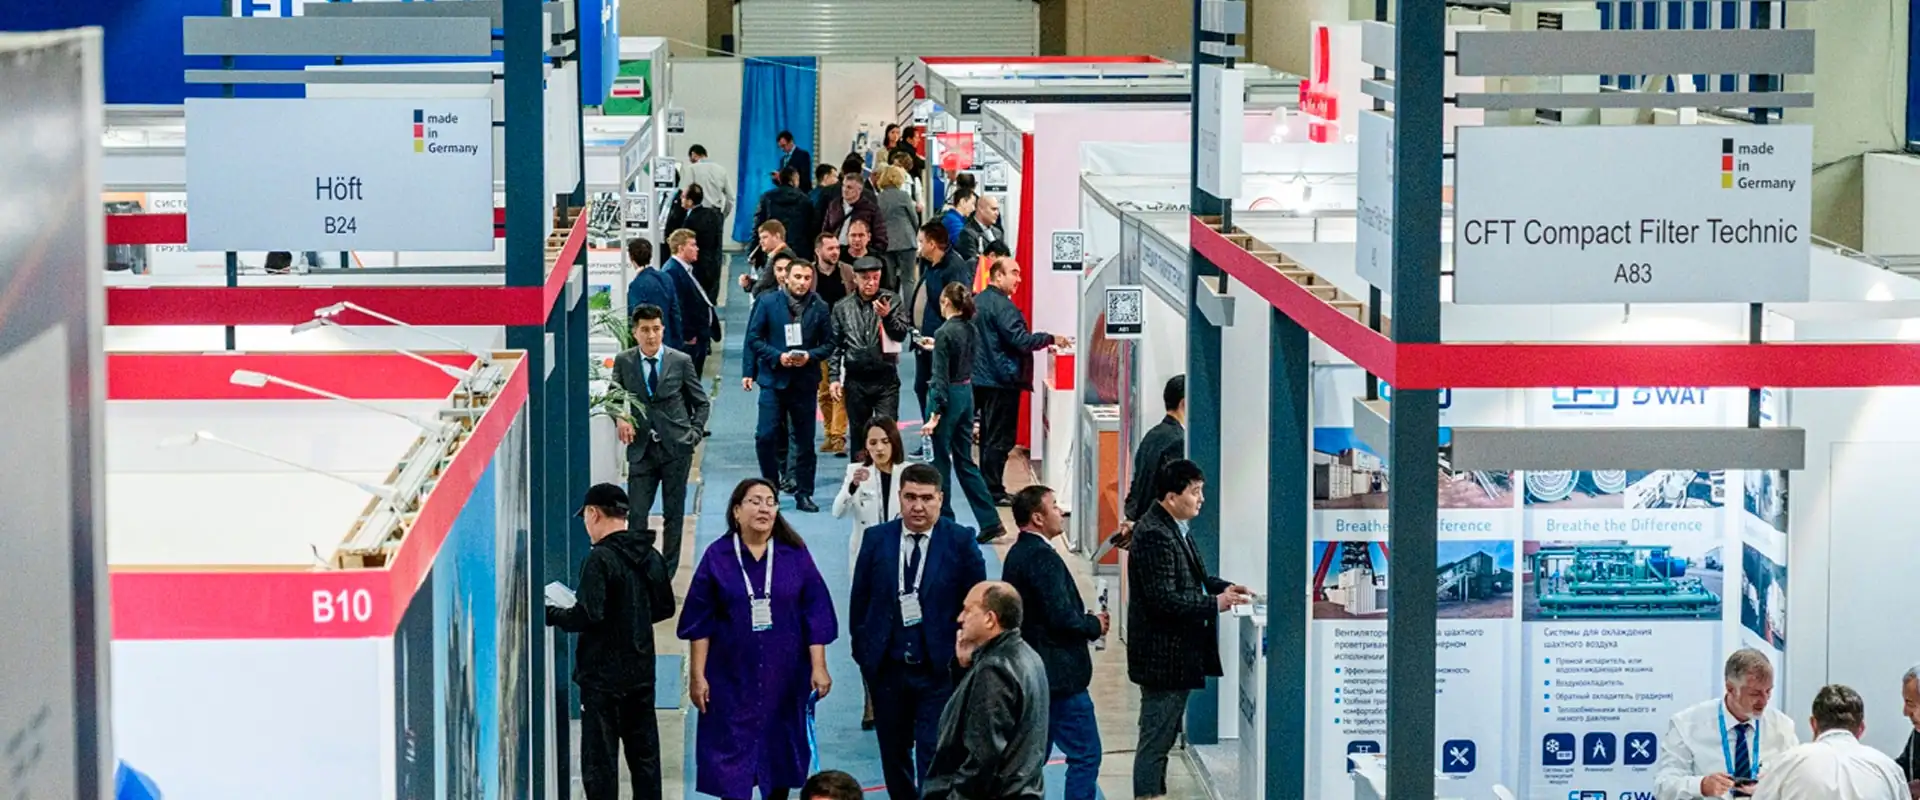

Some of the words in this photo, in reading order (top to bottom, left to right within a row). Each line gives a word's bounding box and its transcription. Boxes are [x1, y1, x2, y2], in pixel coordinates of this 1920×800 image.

[427, 112, 459, 124] made
[427, 127, 438, 139] in
[427, 142, 478, 156] Germany
[1738, 142, 1774, 155] made
[1738, 160, 1750, 172] in
[316, 176, 363, 200] Höft
[1738, 177, 1796, 192] Germany
[325, 216, 357, 234] B24
[1464, 219, 1516, 245] CFT
[1523, 218, 1632, 250] Compact
[1640, 218, 1700, 244] Filter
[1707, 217, 1798, 244] Technic
[1614, 263, 1653, 284] A83
[1546, 518, 1600, 532] Breathe
[1604, 519, 1626, 532] the
[1631, 518, 1703, 532] Difference
[312, 588, 373, 623] B10
[1543, 627, 1580, 637] Системы
[1582, 628, 1599, 637] для
